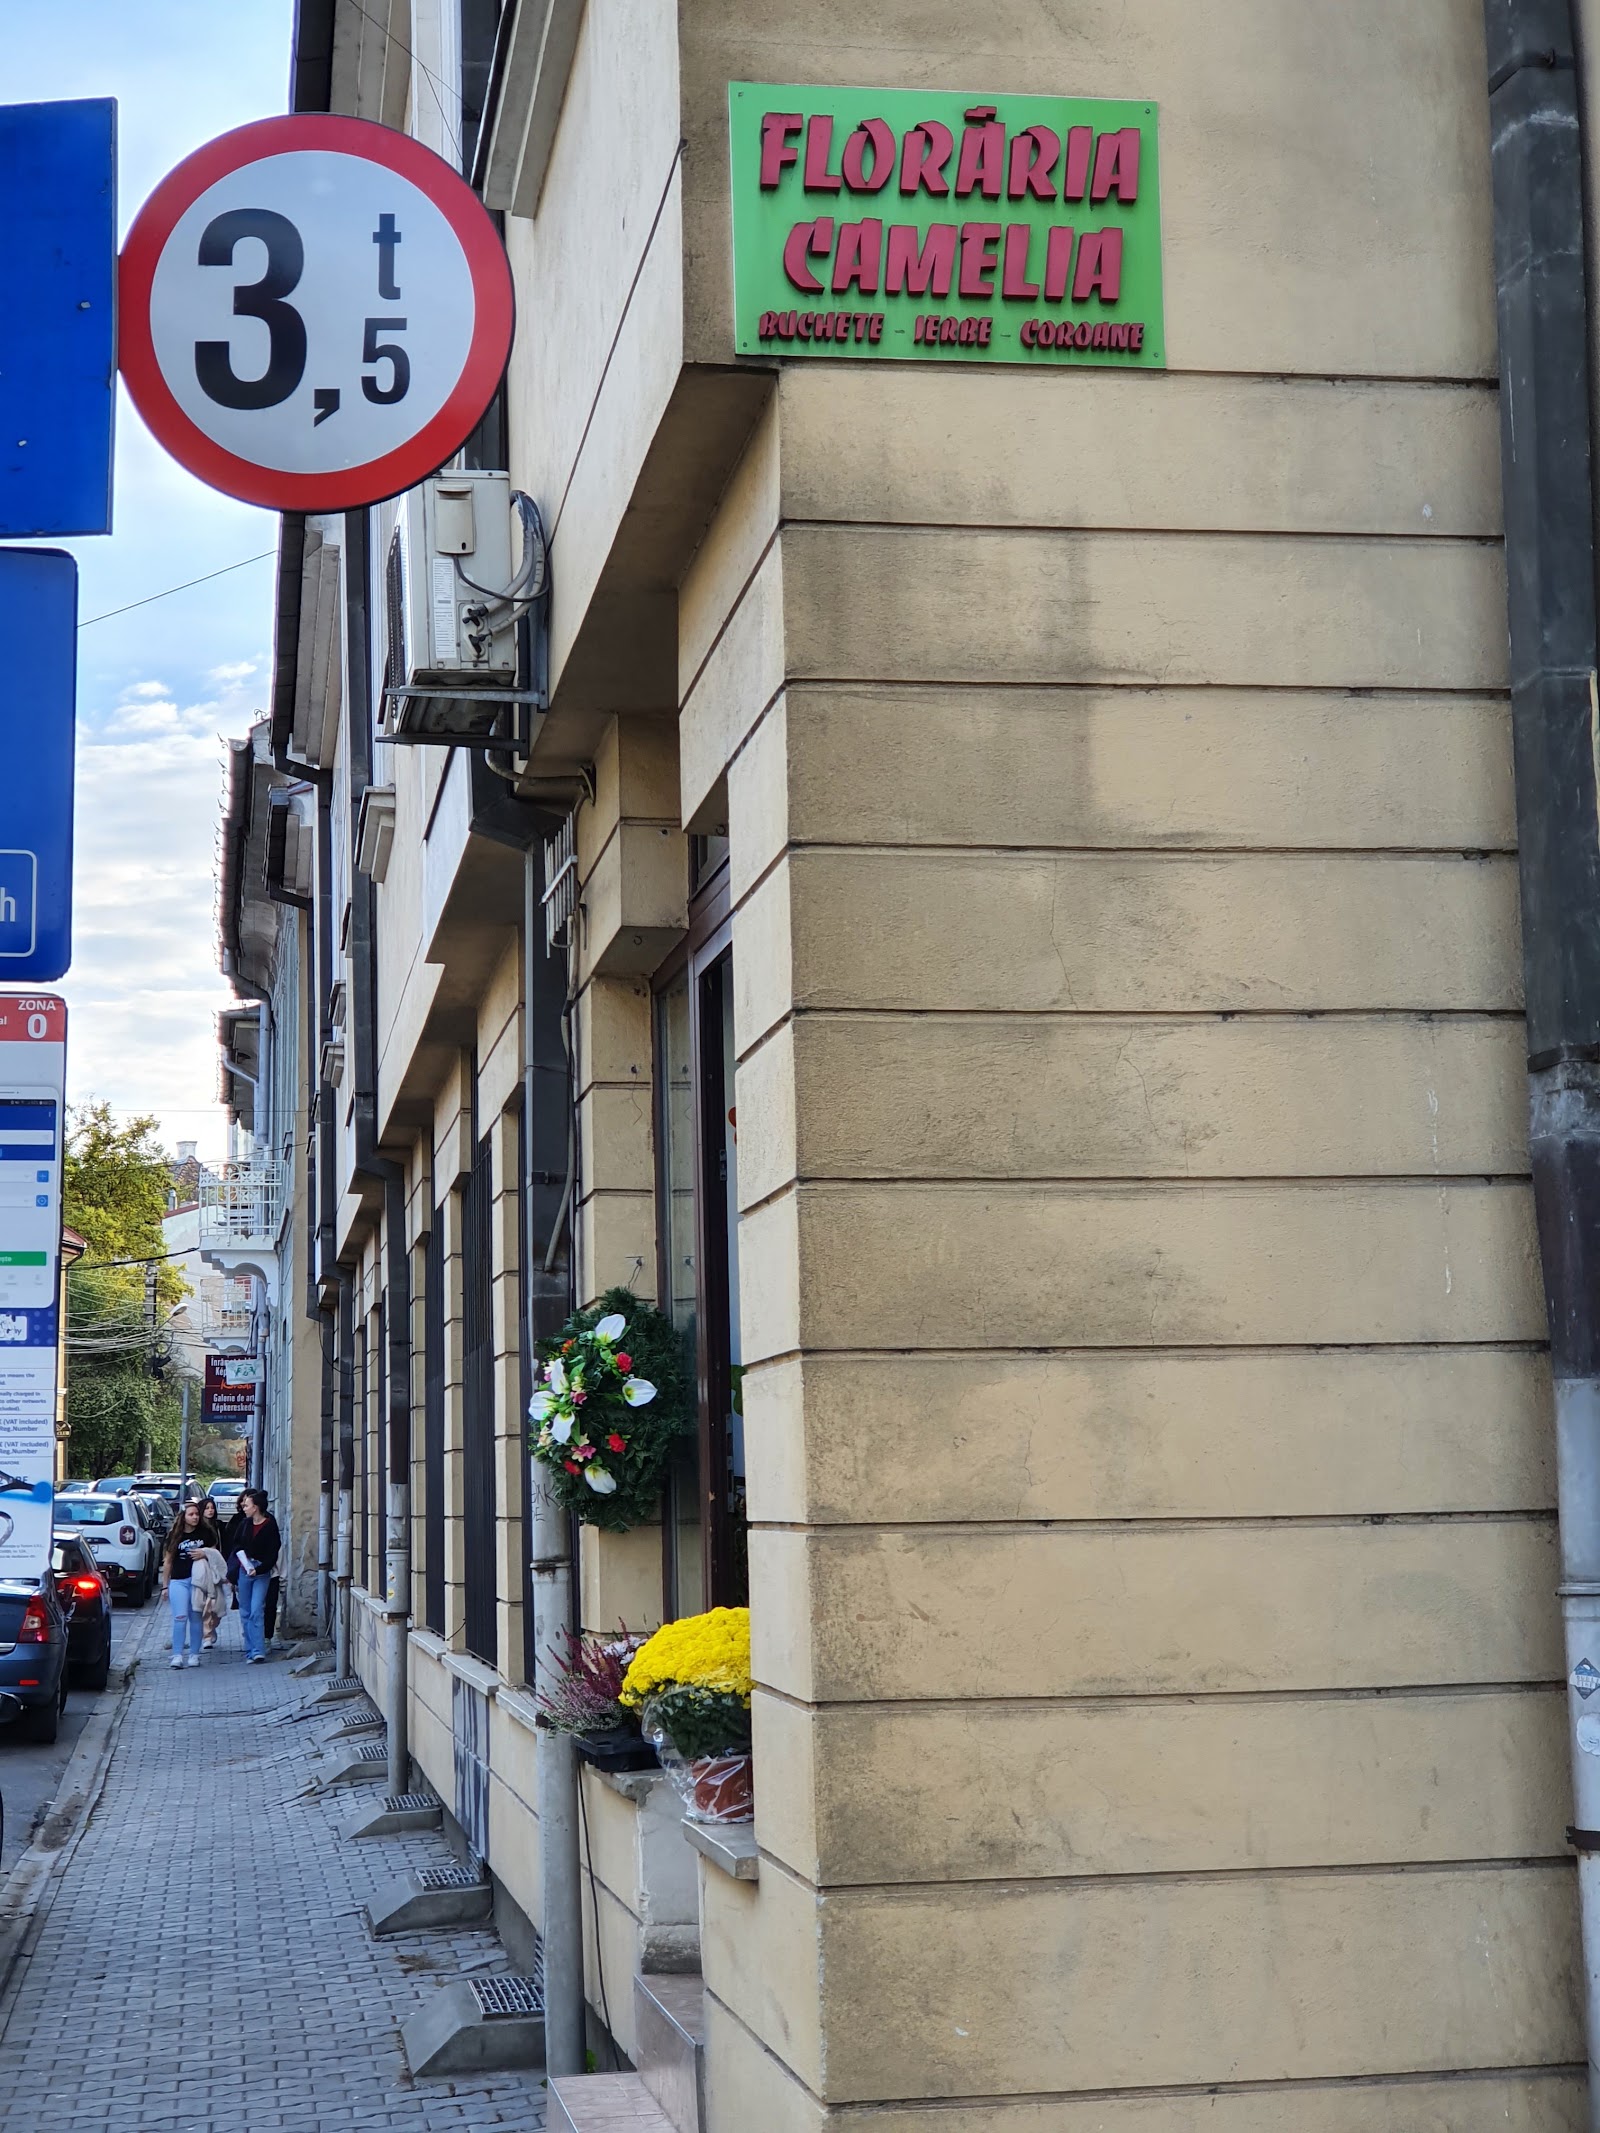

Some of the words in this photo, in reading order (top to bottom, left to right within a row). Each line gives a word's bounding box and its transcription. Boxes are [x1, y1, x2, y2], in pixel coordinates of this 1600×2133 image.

[372, 213, 402, 301] t
[784, 217, 1124, 303] CAMELIA
[759, 310, 884, 344] BUCHETE
[1020, 318, 1145, 352] COROANE
[18, 1000, 57, 1011] ZONA
[213, 1393, 235, 1403] Galerie
[237, 1393, 245, 1402] de
